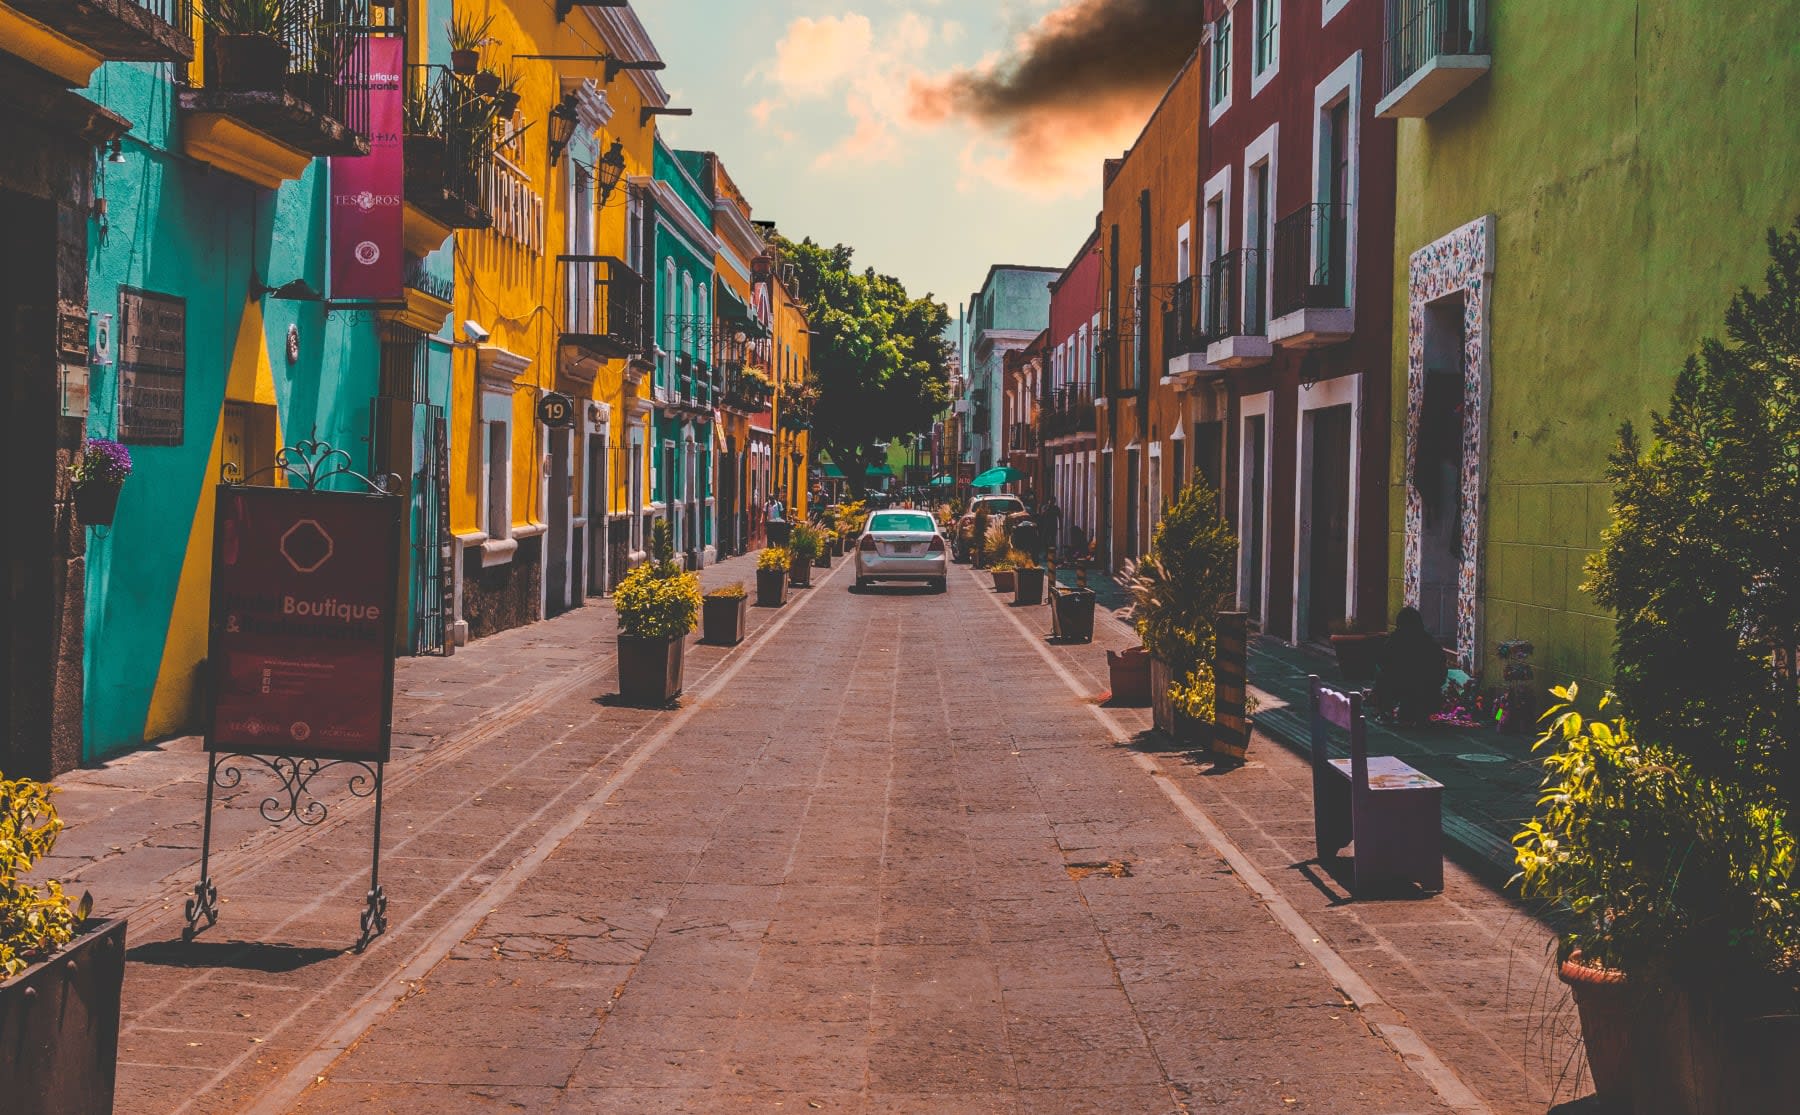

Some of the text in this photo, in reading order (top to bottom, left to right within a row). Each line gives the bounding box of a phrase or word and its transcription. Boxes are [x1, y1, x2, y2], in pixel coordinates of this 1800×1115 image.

[544, 403, 564, 419] 19
[283, 596, 380, 622] Boutique
[226, 614, 240, 633] &
